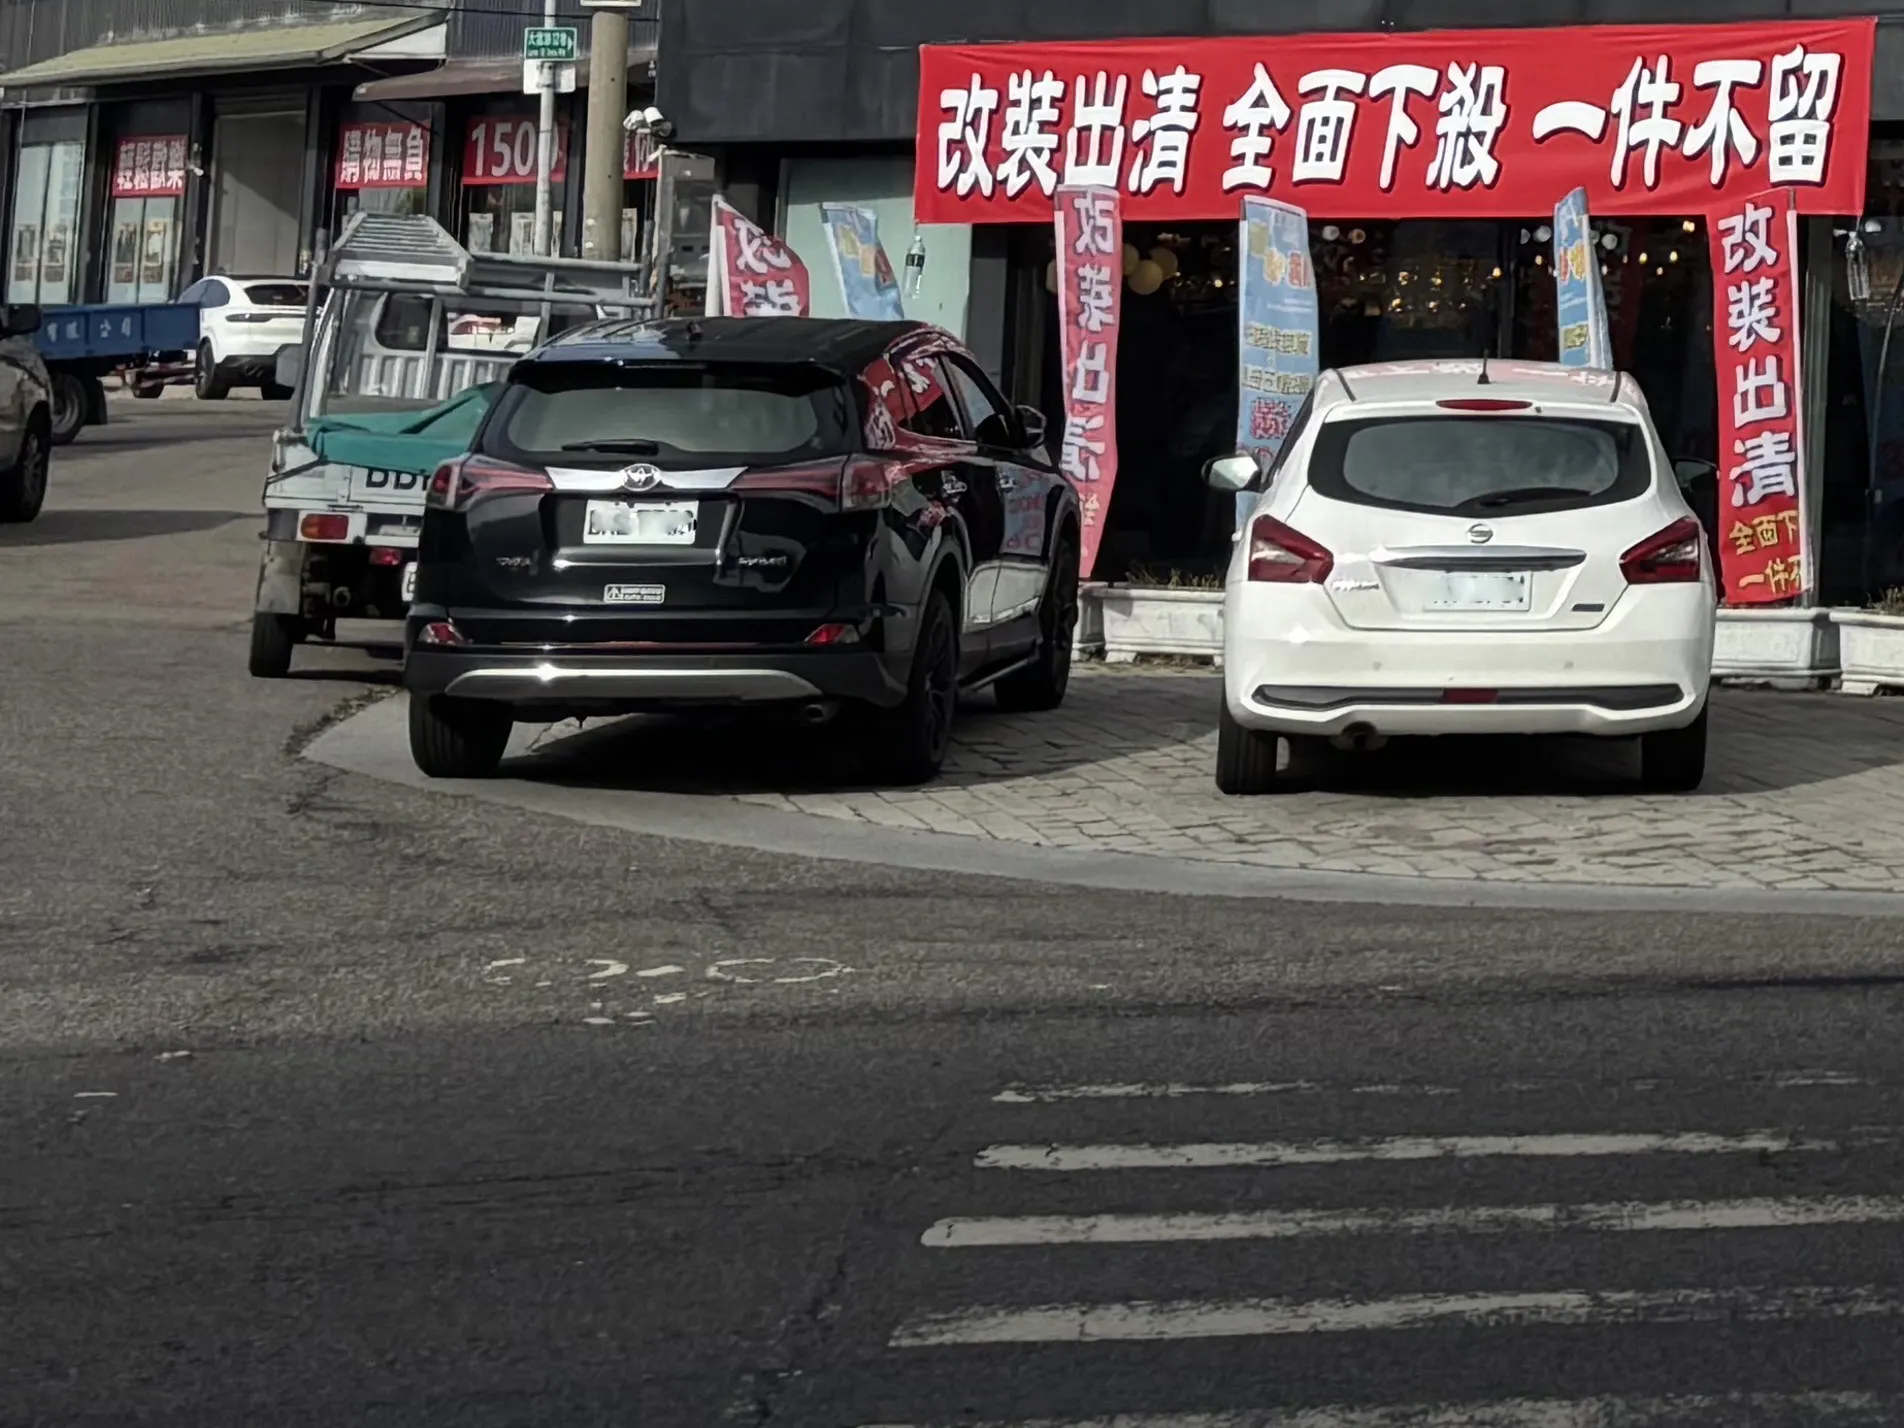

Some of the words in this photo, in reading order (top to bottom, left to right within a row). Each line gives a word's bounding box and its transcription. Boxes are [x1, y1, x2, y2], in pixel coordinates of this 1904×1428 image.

[936, 66, 1203, 199] 改裝出清
[1221, 60, 1508, 194] 全面下殺
[1532, 44, 1843, 188] 一件不留
[1717, 201, 1796, 508] 改裝出清
